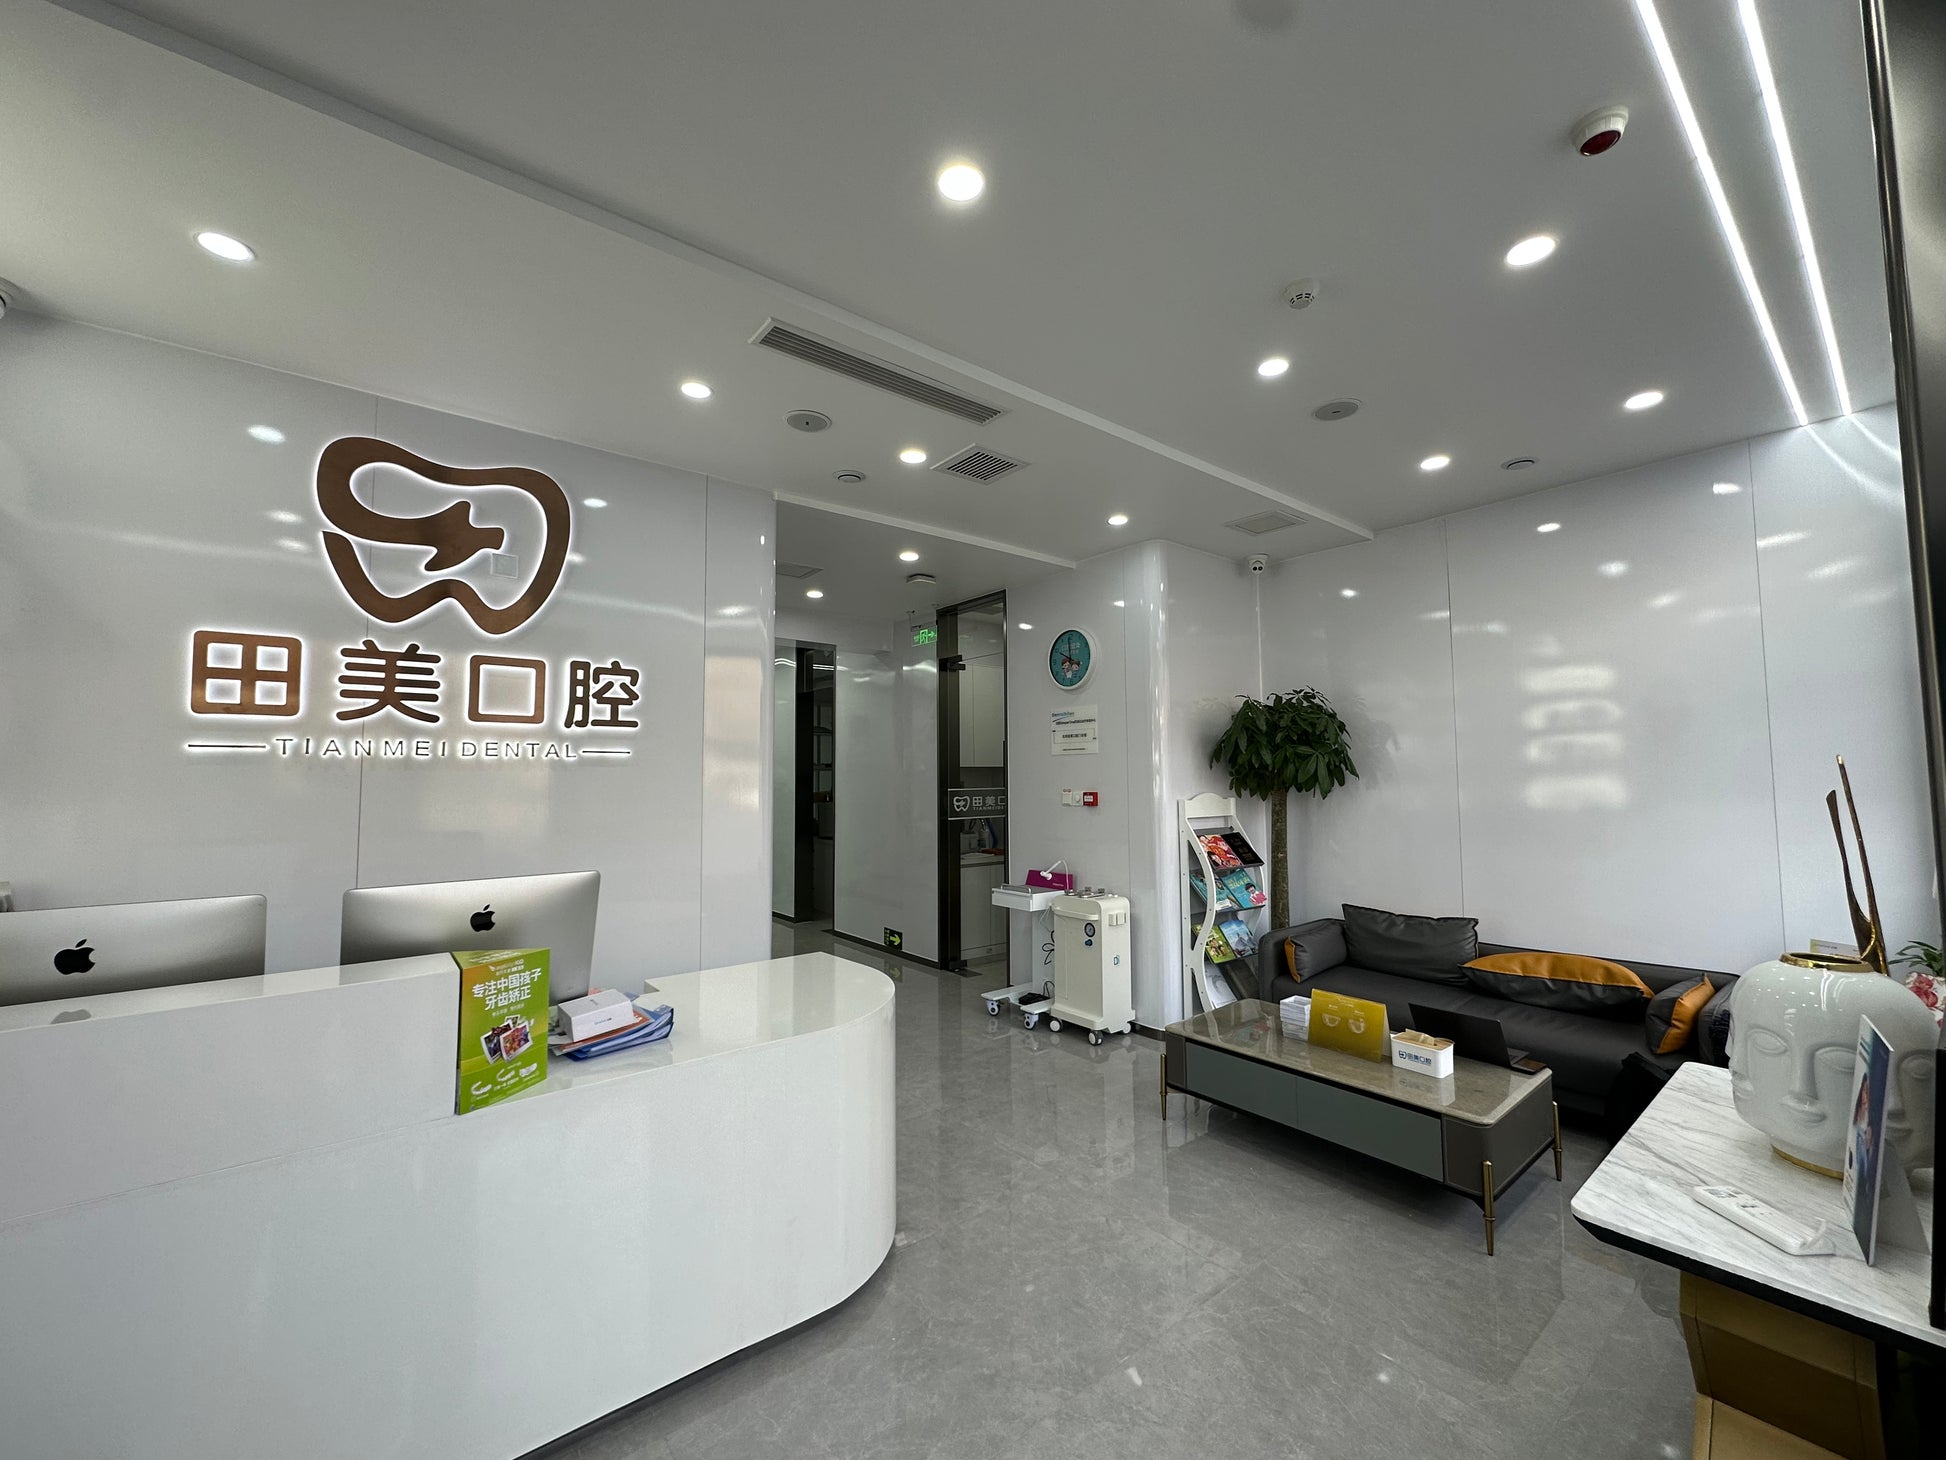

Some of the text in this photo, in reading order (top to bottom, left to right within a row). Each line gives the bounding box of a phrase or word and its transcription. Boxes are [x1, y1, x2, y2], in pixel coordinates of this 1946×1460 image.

[191, 630, 639, 729] 田美口腔
[275, 738, 577, 758] TIANMEI DENTAL
[472, 967, 542, 998] 专注中国孩子
[485, 985, 531, 1011] 牙齿矫正
